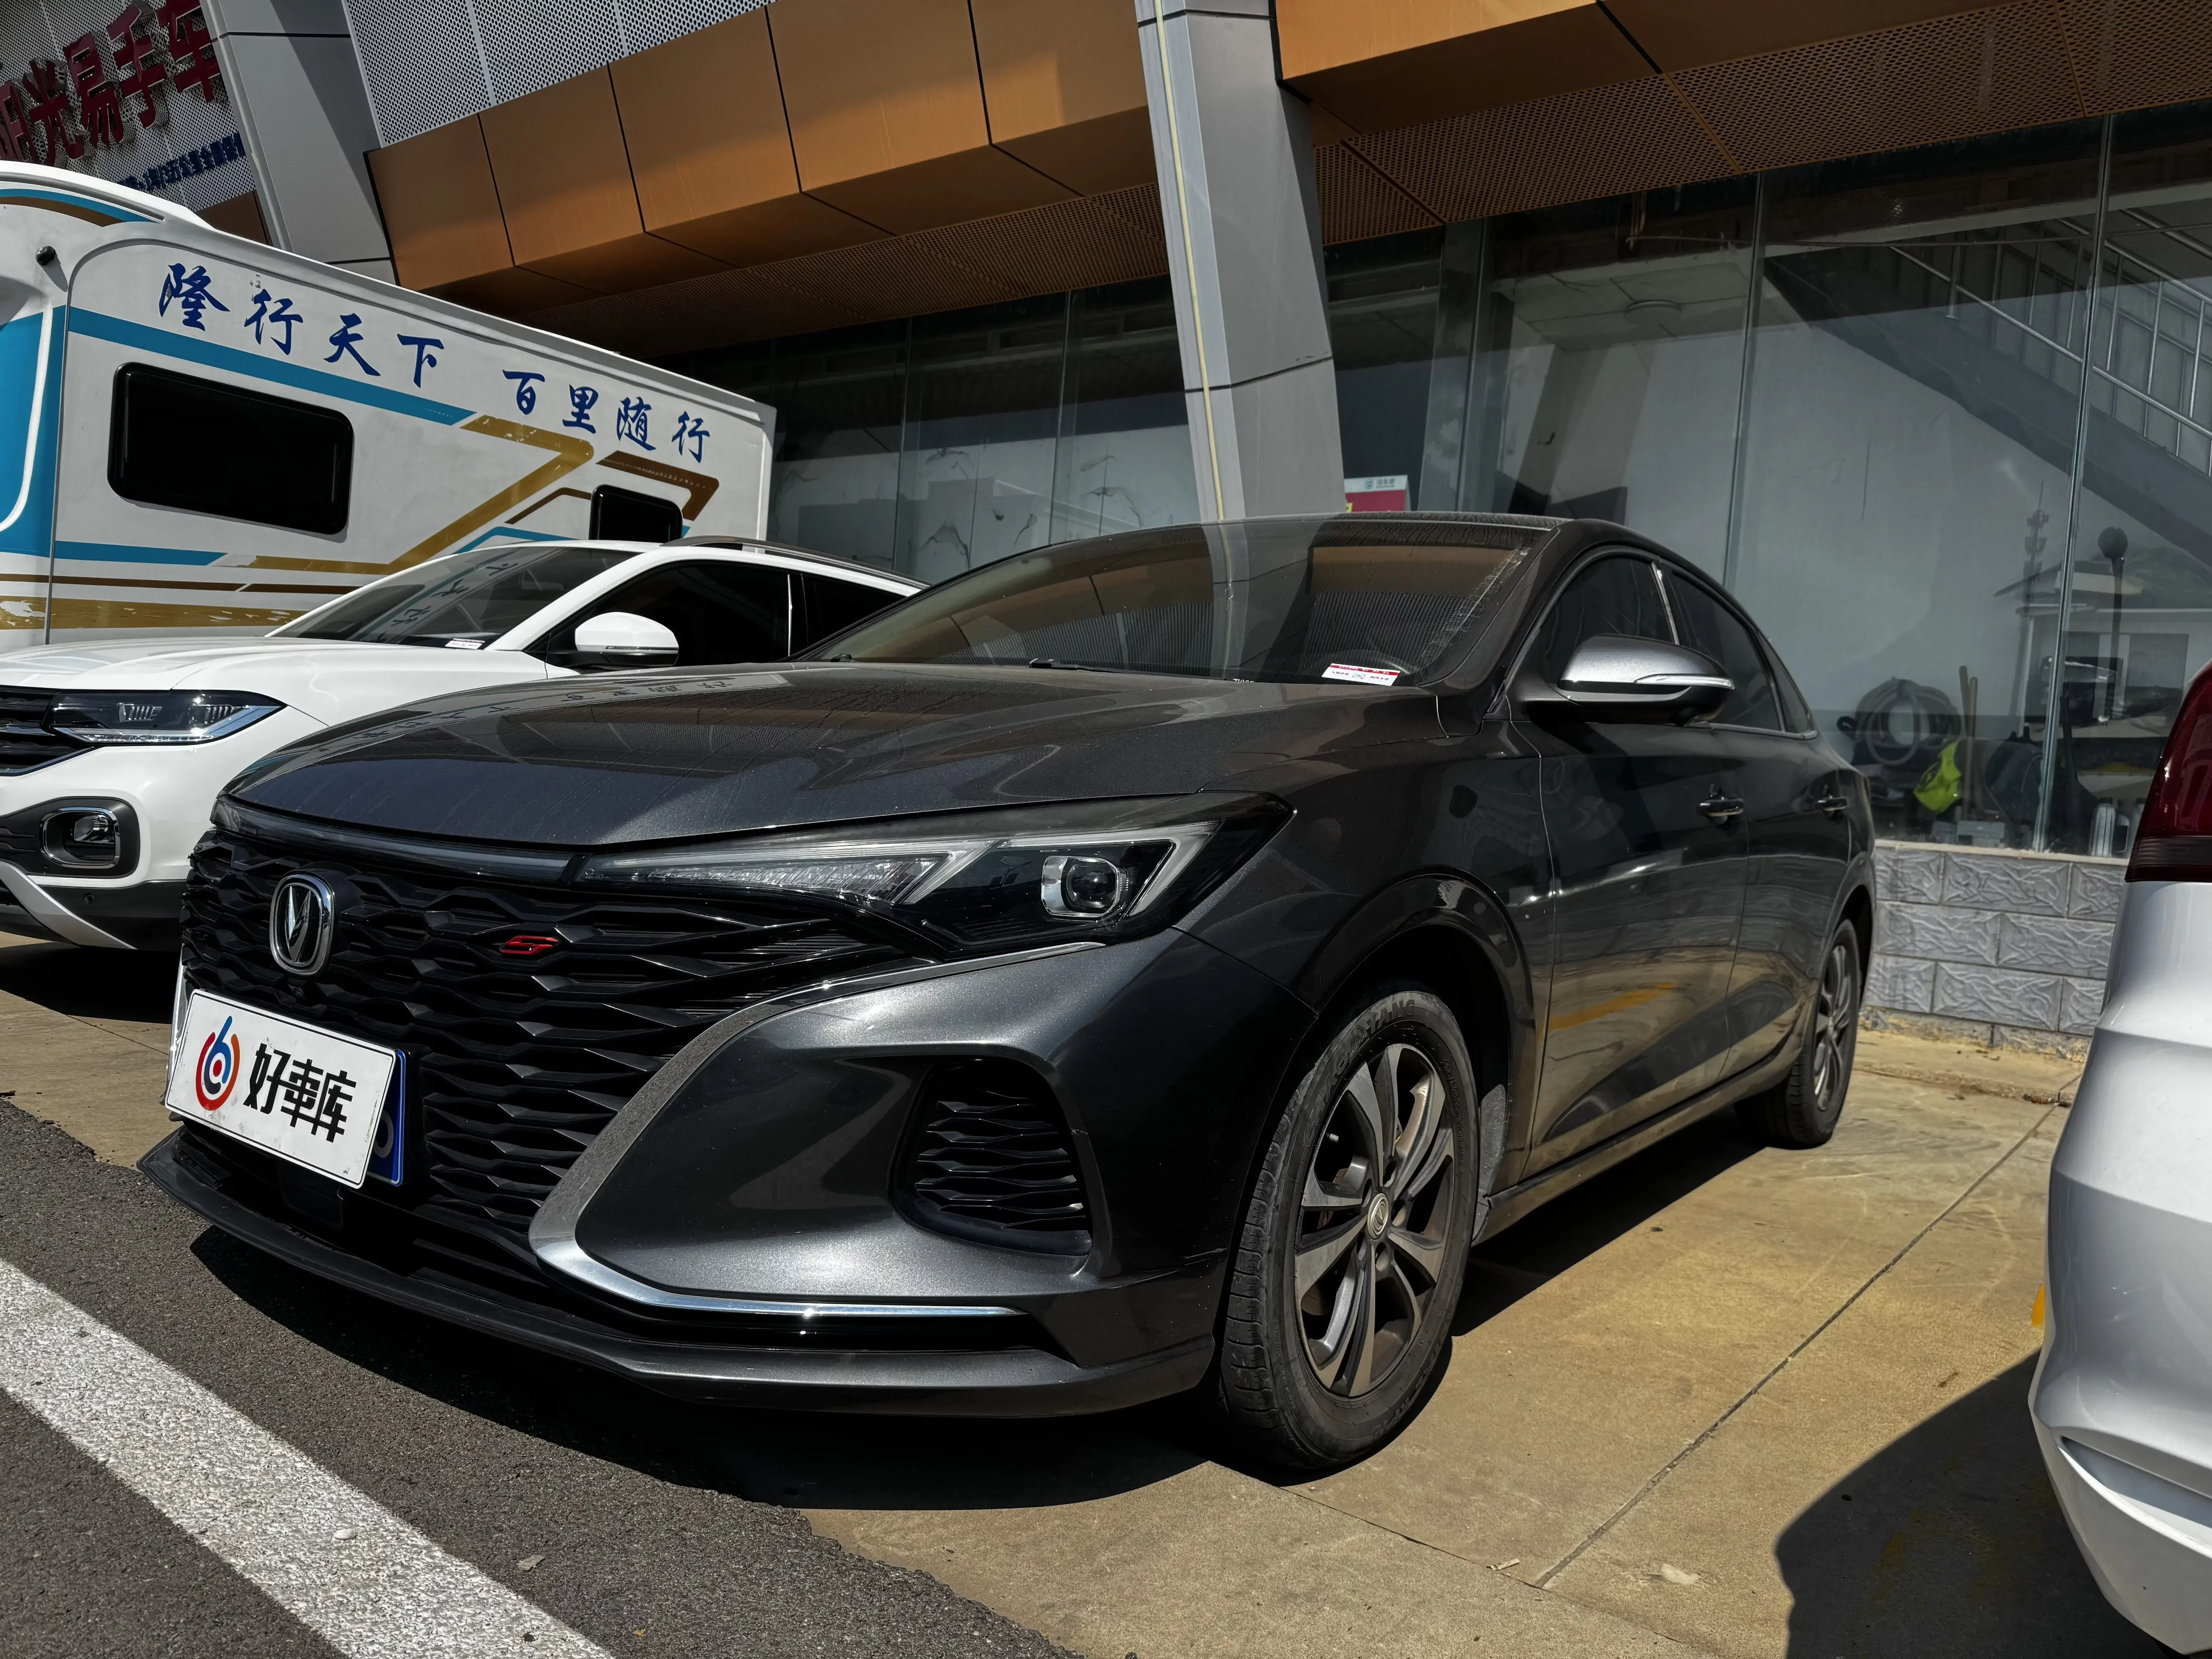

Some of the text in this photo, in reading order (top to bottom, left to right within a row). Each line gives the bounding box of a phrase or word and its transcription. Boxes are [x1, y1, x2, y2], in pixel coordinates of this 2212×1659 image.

[159, 263, 710, 463] 隆行天下 百里随行
[1360, 999, 1415, 1035] YANG
